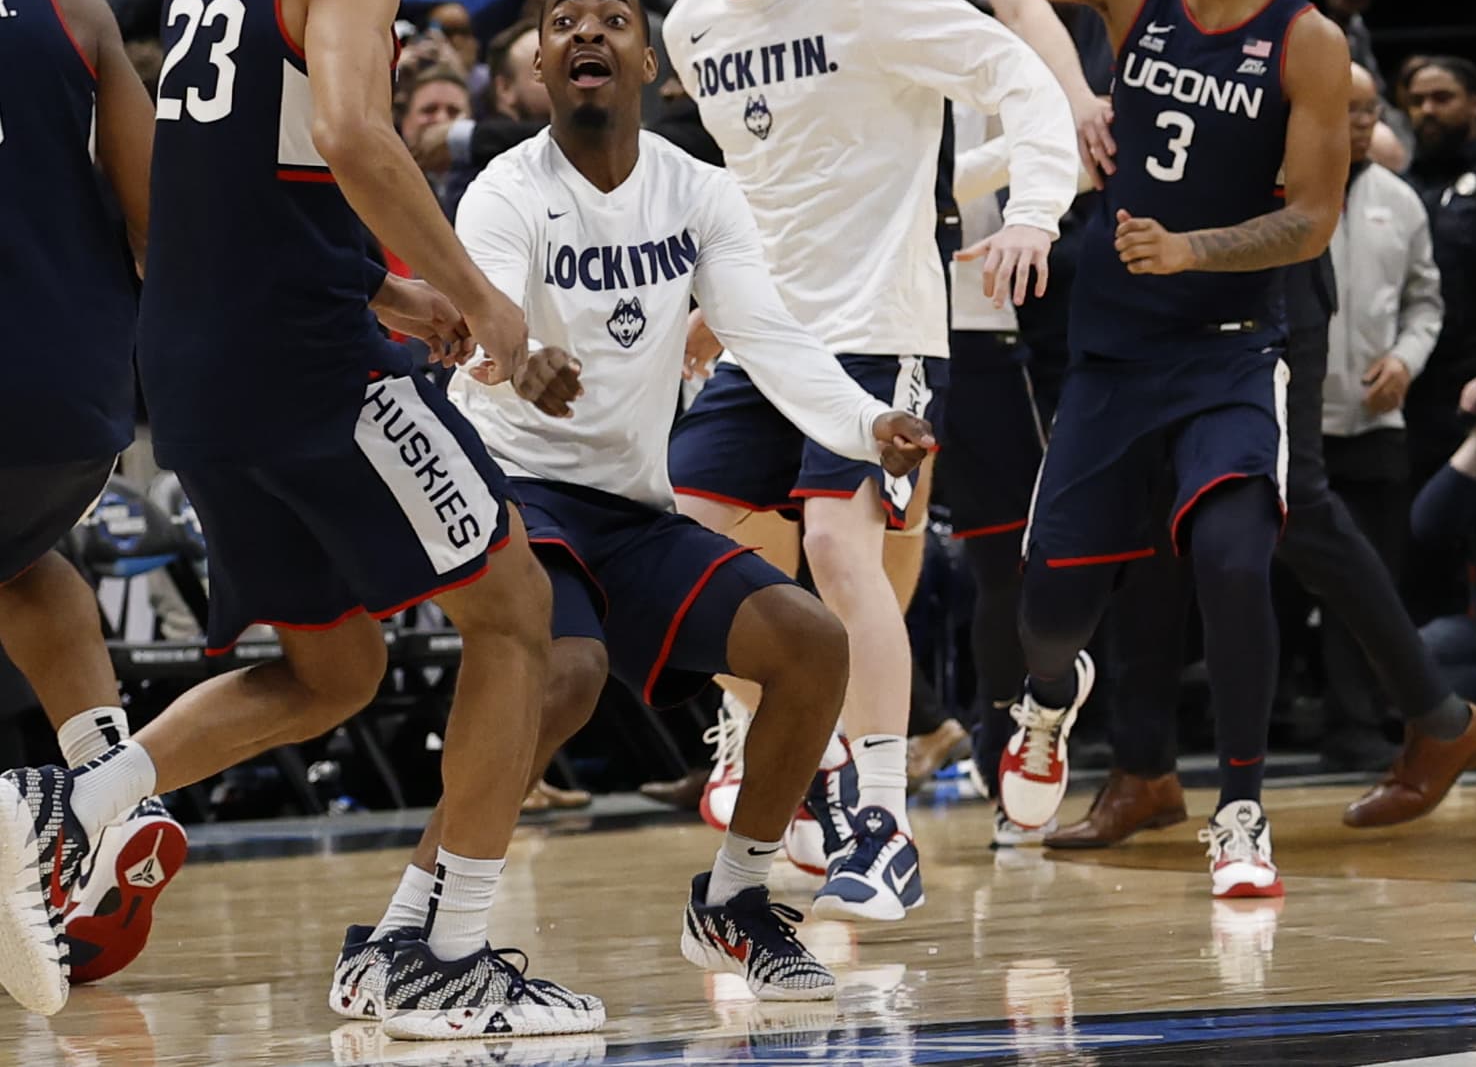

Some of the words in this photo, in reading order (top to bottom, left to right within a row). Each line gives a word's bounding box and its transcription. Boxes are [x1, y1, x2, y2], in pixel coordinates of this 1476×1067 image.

[760, 41, 787, 86] IT
[792, 34, 839, 79] IN.
[1122, 51, 1265, 120] UCONN
[1144, 109, 1197, 183] 3
[543, 240, 629, 292] LOCK
[627, 240, 659, 287] IT
[361, 384, 482, 550] HUSKIES
